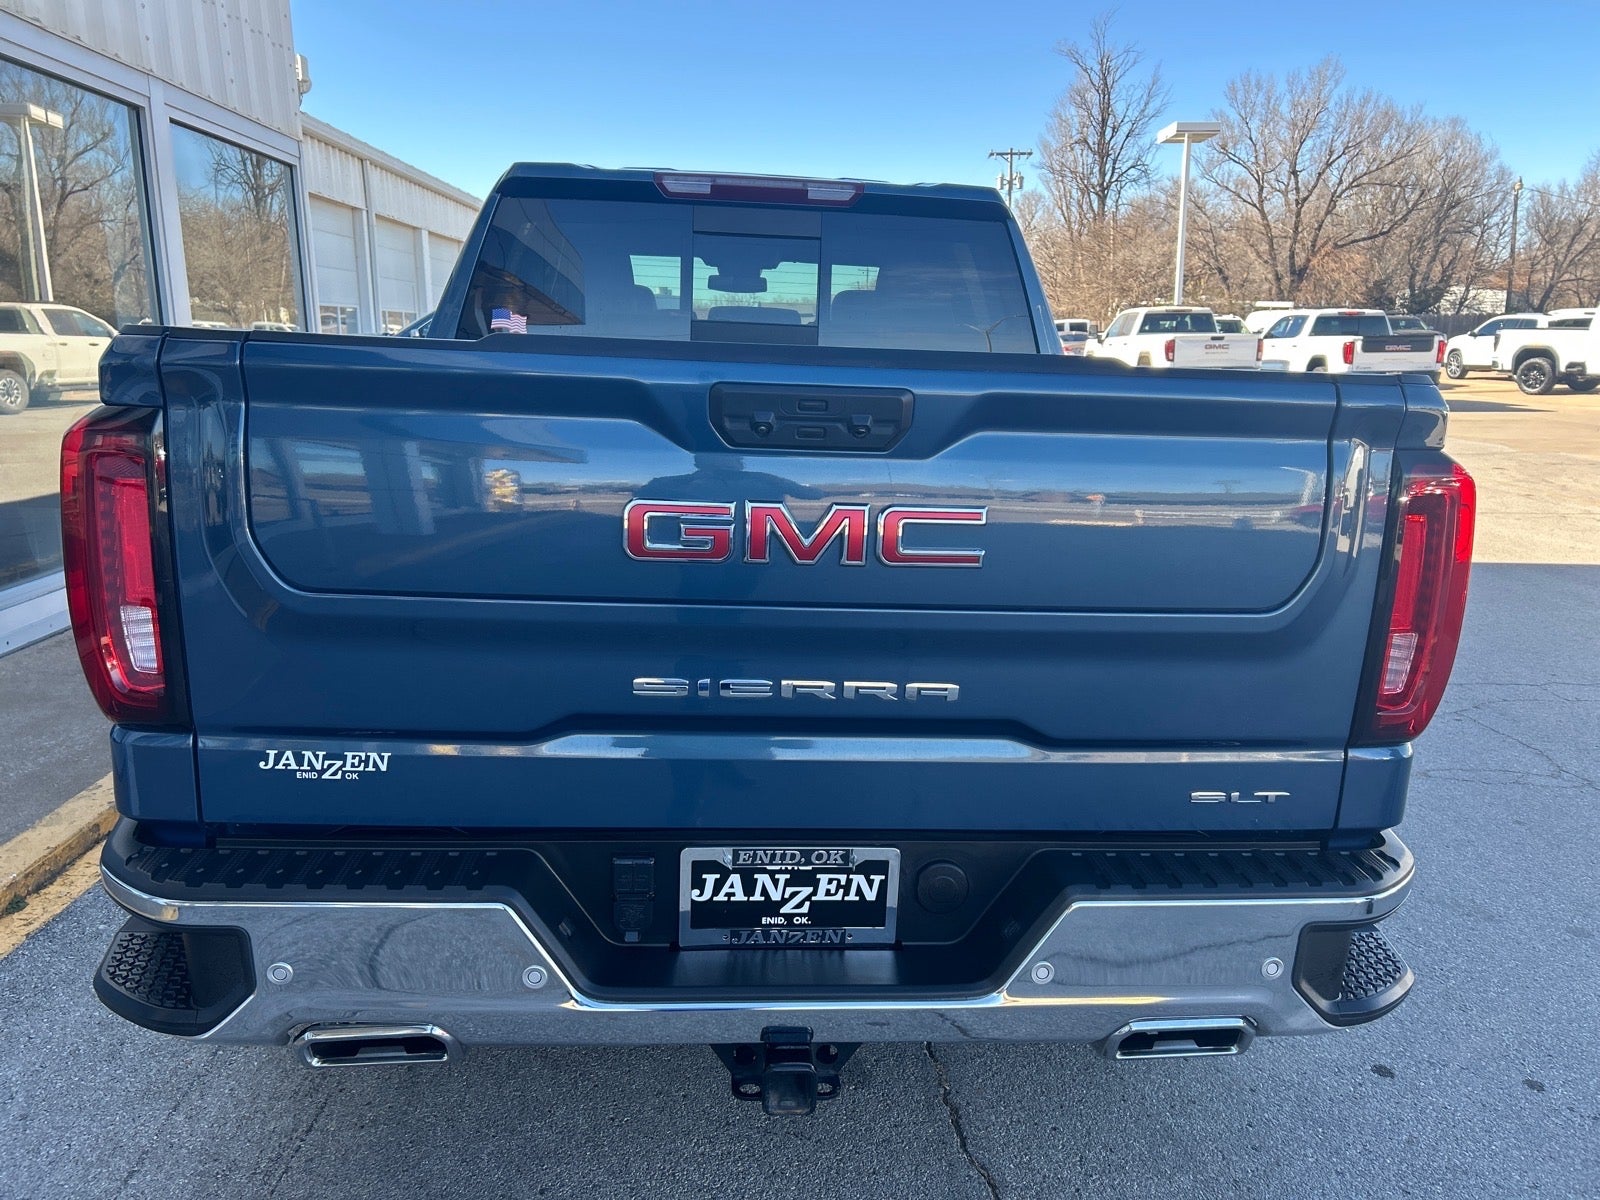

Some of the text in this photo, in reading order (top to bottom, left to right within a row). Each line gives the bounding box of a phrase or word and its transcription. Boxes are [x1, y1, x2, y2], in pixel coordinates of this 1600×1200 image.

[623, 498, 988, 567] GMC
[632, 678, 960, 701] SIERRA
[259, 749, 392, 780] JANZEN
[296, 771, 359, 780] ENID OK
[1190, 791, 1291, 803] SLT
[736, 849, 845, 865] ENID, OK
[691, 873, 886, 914] JANZEN
[761, 916, 812, 926] ENID, OK.
[731, 929, 847, 944] JANZEN
